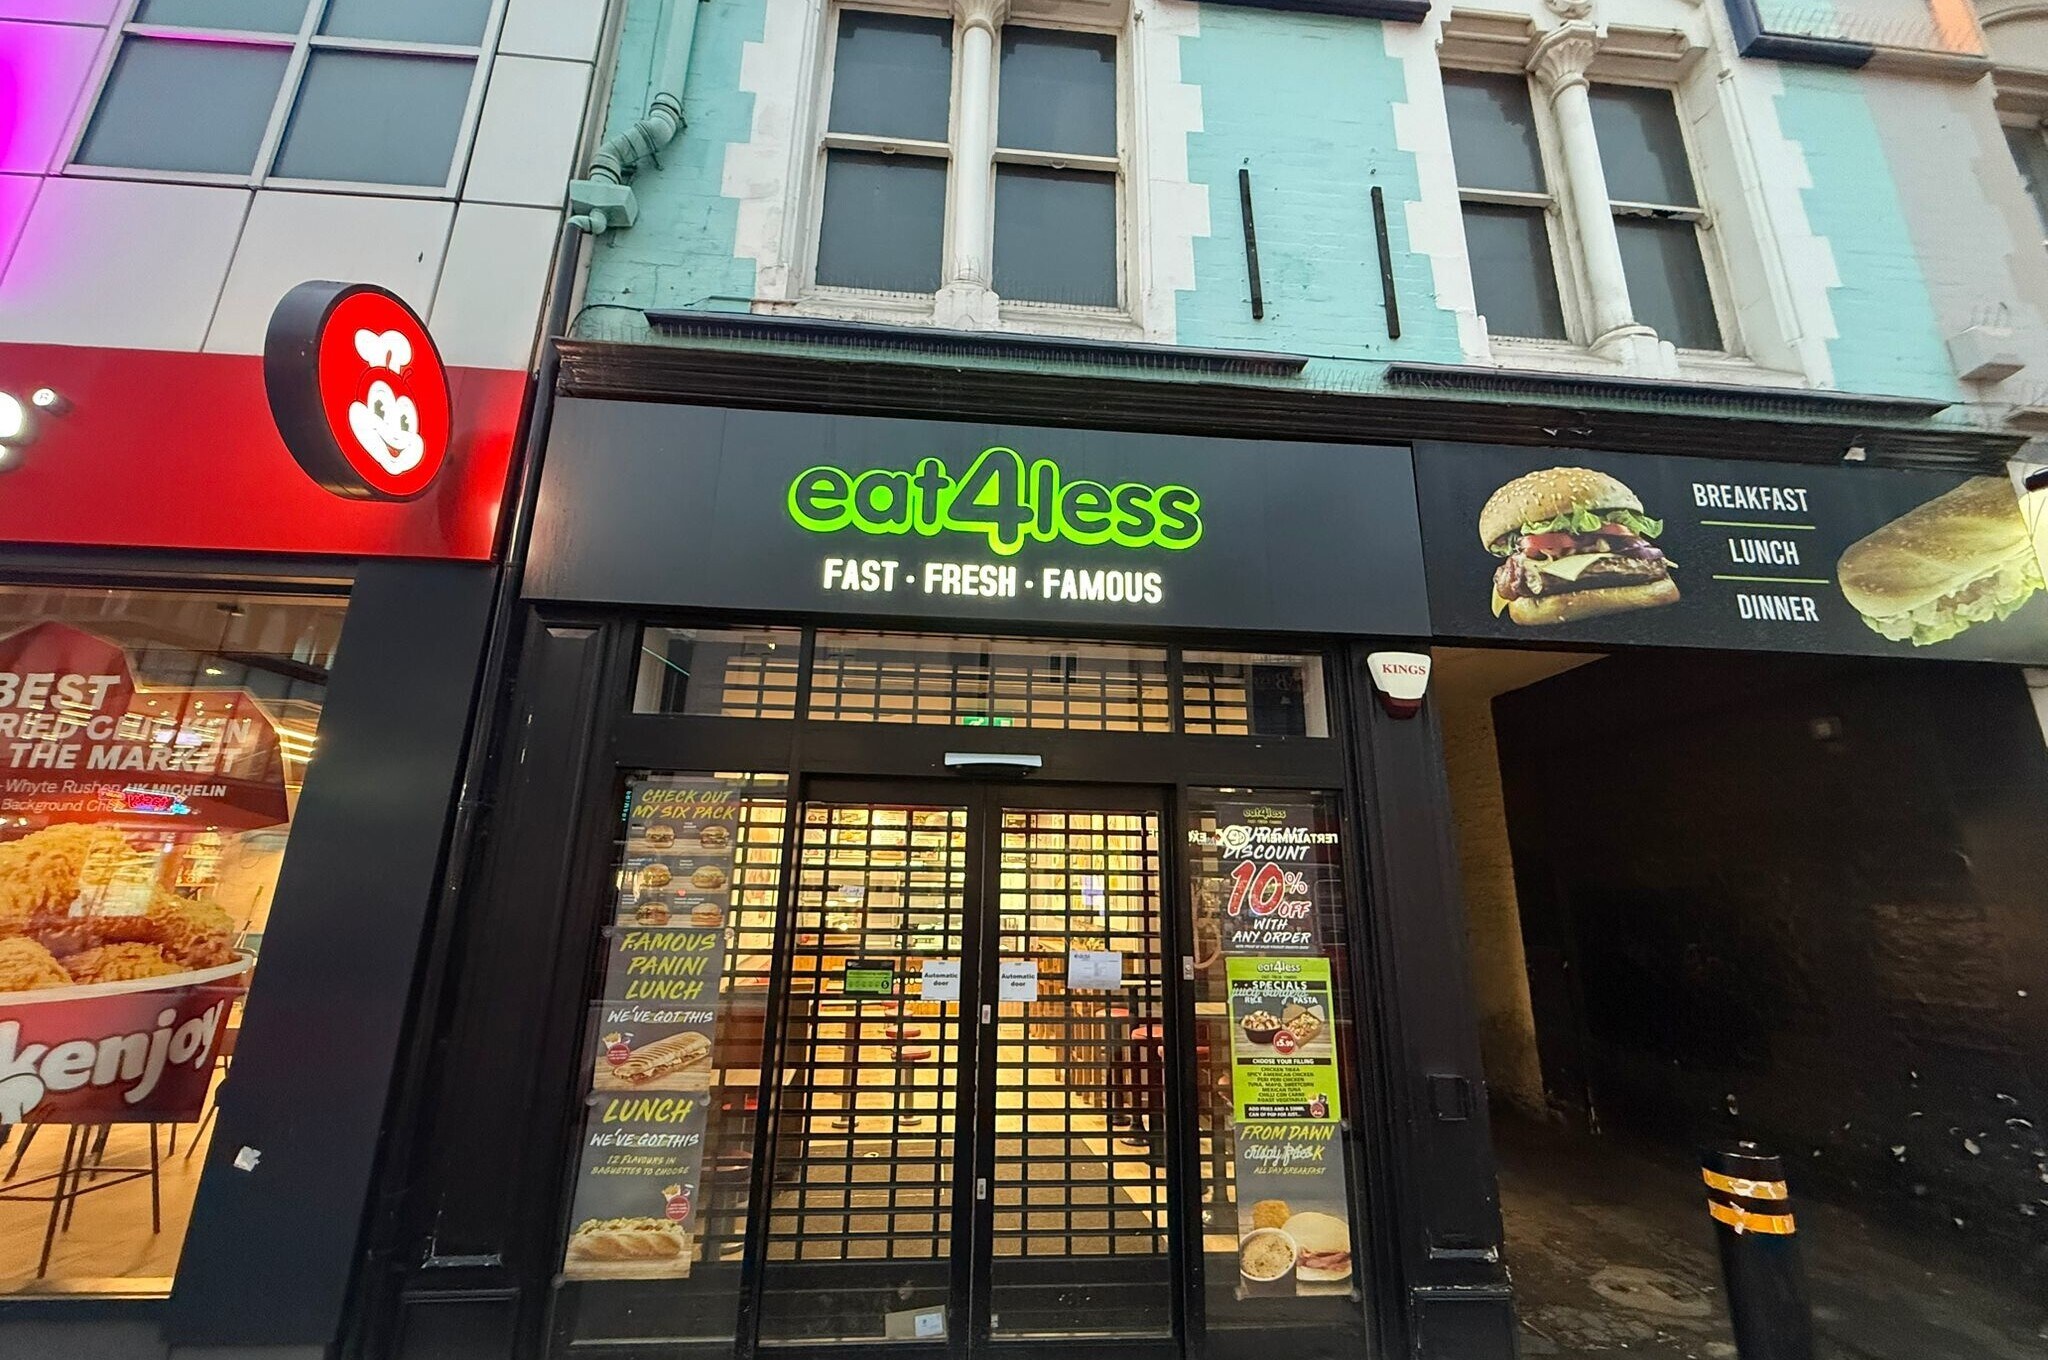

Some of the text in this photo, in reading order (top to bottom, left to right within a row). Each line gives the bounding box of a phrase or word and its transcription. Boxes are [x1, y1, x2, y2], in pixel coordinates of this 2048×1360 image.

[787, 446, 1203, 556] eat4less
[1692, 483, 1808, 512] BREAKFAST
[1728, 538, 1800, 565] LUNCH
[823, 558, 1162, 603] FAST FRESH FAMOUS
[1736, 594, 1819, 622] DINNER
[1382, 664, 1426, 675] KINGS
[0, 672, 120, 710] BEST
[86, 715, 251, 744] CHICKEN
[10, 742, 242, 773] THE MARKET
[642, 788, 733, 803] CHECK OUT
[2, 799, 83, 812] Background
[87, 800, 121, 812] Che
[632, 805, 736, 820] MY SIX PACK
[1223, 845, 1310, 861] DISCOUNT
[1278, 901, 1312, 919] OFF
[1253, 918, 1288, 930] WITH
[620, 932, 716, 952] FAMOUS
[1232, 930, 1312, 944] ANY ORDER
[627, 956, 707, 976] PANINI
[1257, 961, 1301, 973] eat4less
[625, 979, 704, 1001] LUNCH
[1252, 981, 1308, 990] SPECIALS
[607, 1006, 713, 1023] WE'VE GOT THIS
[603, 1098, 693, 1123] LUNCH
[589, 1128, 699, 1147] WE'VE GOT THIS
[1240, 1125, 1336, 1141] FROM DAWN
[607, 1155, 619, 1164] 12
[666, 1156, 676, 1165] IN
[643, 1167, 653, 1175] TO
[654, 1166, 690, 1176] CHOOSE
[1283, 1167, 1326, 1175] BREAKFAST
